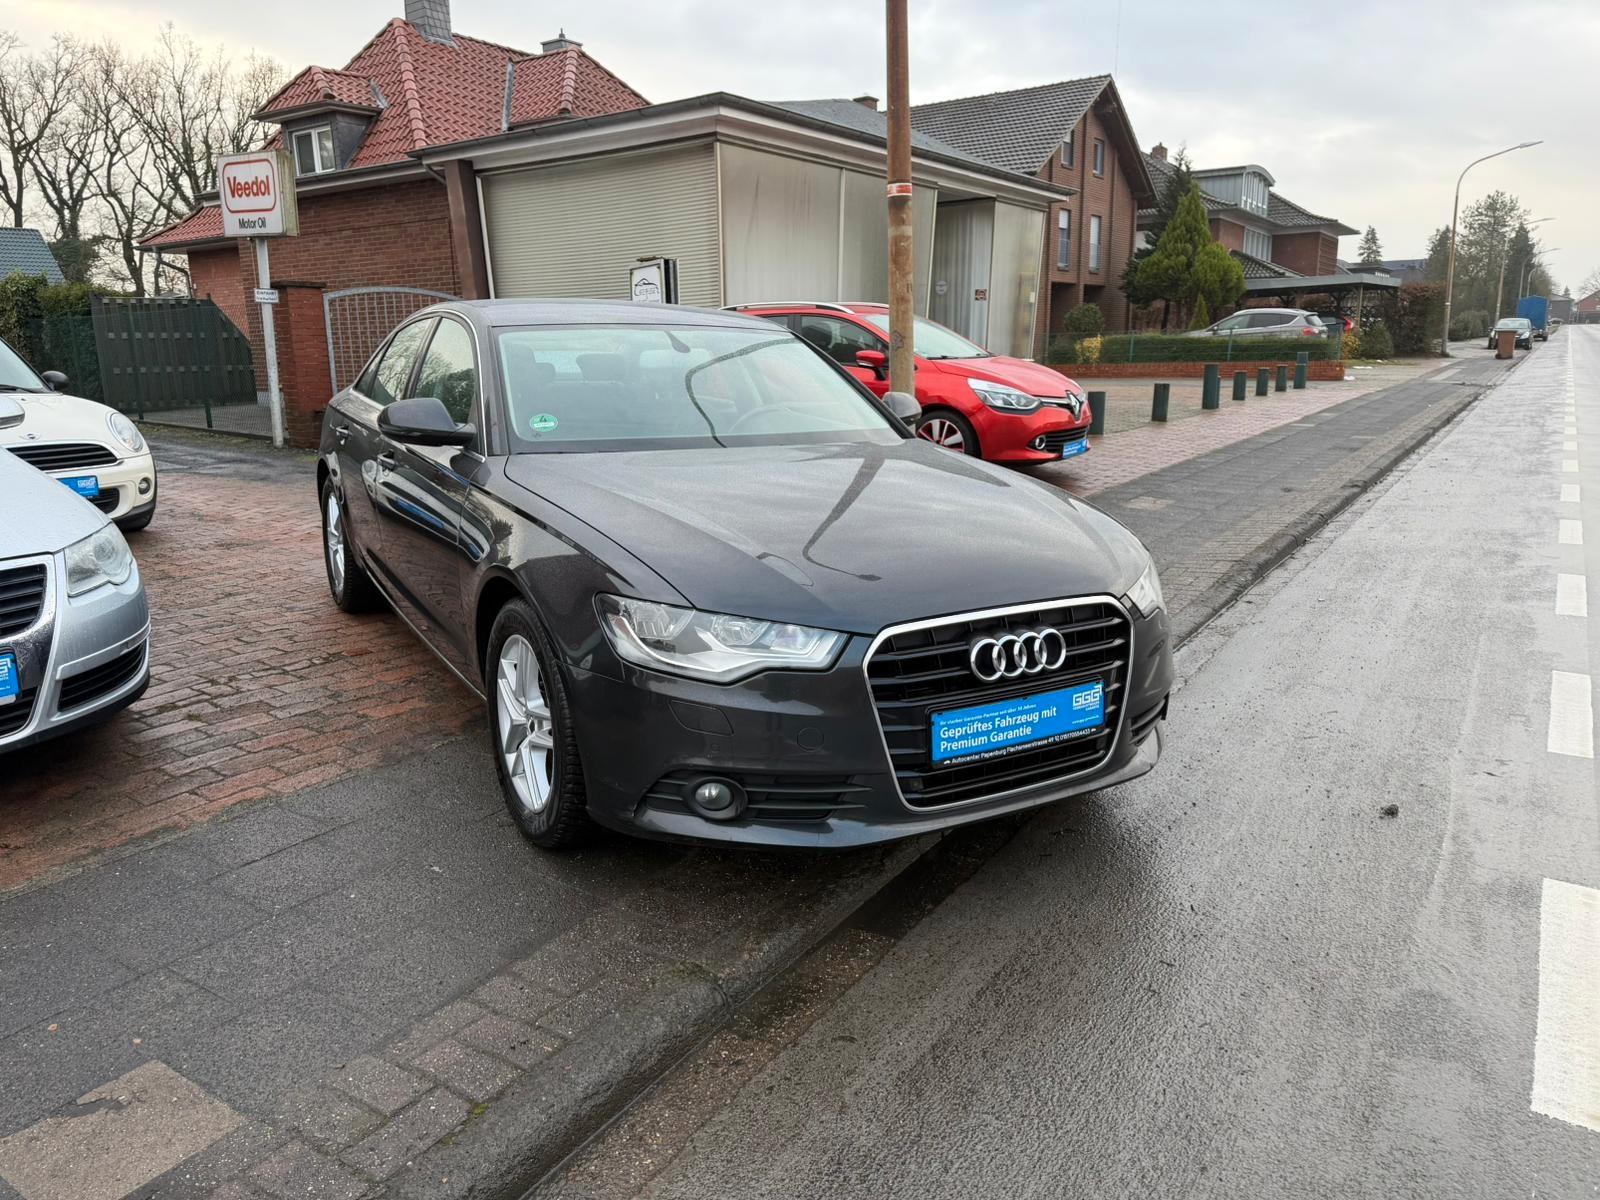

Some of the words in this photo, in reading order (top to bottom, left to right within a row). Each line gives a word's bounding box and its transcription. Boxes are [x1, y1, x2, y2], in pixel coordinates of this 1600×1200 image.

[227, 175, 271, 198] Veedol
[238, 218, 256, 229] Motor
[257, 216, 267, 229] Oil
[1072, 687, 1100, 707] GGG
[940, 721, 993, 739] Geprüftes
[994, 711, 1039, 729] Fahrzeug
[1041, 705, 1057, 719] mit
[940, 736, 988, 753] Premium
[990, 725, 1032, 743] Garantie
[951, 753, 981, 764] Autocenter
[980, 748, 1007, 759] Papenburg
